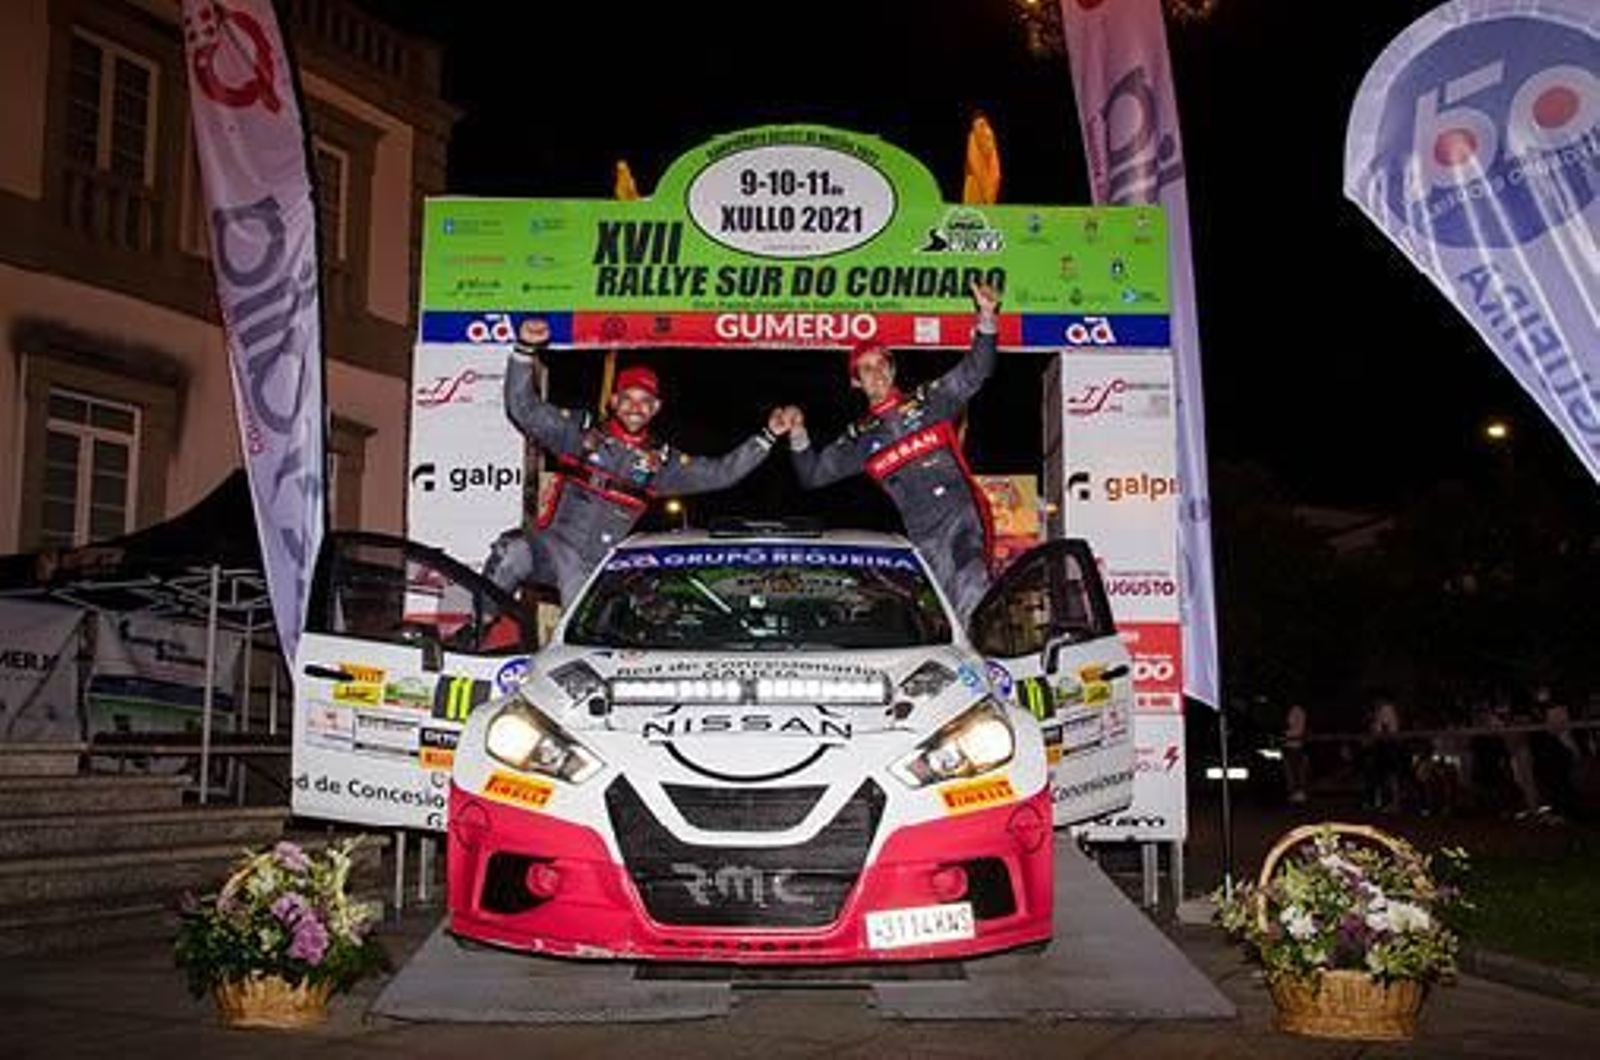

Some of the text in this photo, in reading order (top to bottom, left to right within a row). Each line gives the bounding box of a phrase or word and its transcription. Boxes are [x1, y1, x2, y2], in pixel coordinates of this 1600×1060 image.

[740, 168, 831, 196] 9-10-11
[720, 206, 863, 233] XULLO 2021
[592, 220, 685, 266] XVII
[595, 265, 1007, 299] RALLYE SUR DO CONDADO
[714, 312, 878, 341] GUMERJO
[1105, 578, 1176, 596] UGUSTO
[641, 713, 853, 739] NISSAN
[314, 775, 341, 795] de
